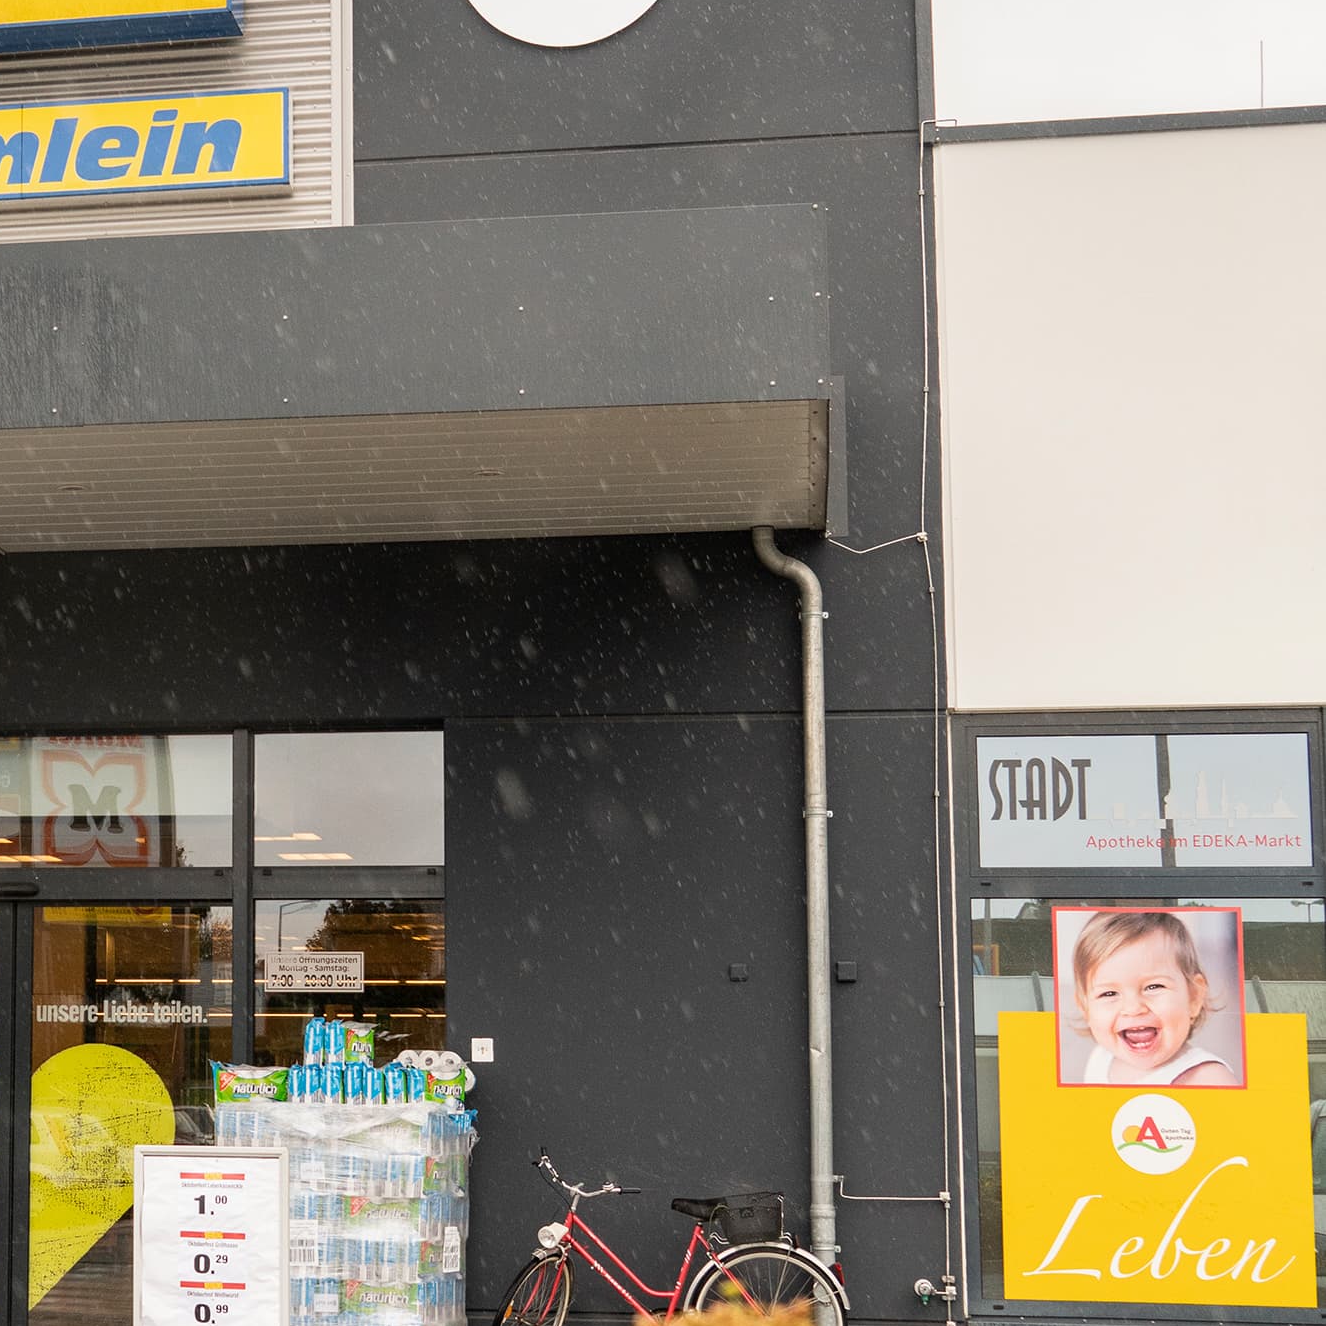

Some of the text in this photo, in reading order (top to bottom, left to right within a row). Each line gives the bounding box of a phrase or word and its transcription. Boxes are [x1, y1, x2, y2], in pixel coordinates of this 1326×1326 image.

[989, 756, 1092, 821] STADT
[1085, 834, 1302, 851] Apotheke im EDEKA-Markt
[279, 964, 308, 973] Montag
[298, 955, 358, 965] Öffnungszeiten
[271, 974, 294, 987] 7:00
[304, 974, 333, 987] 20:00
[336, 974, 358, 987] Uhr
[36, 1000, 209, 1024] unsere Liebe teilen.
[1022, 1156, 1297, 1284] Leben
